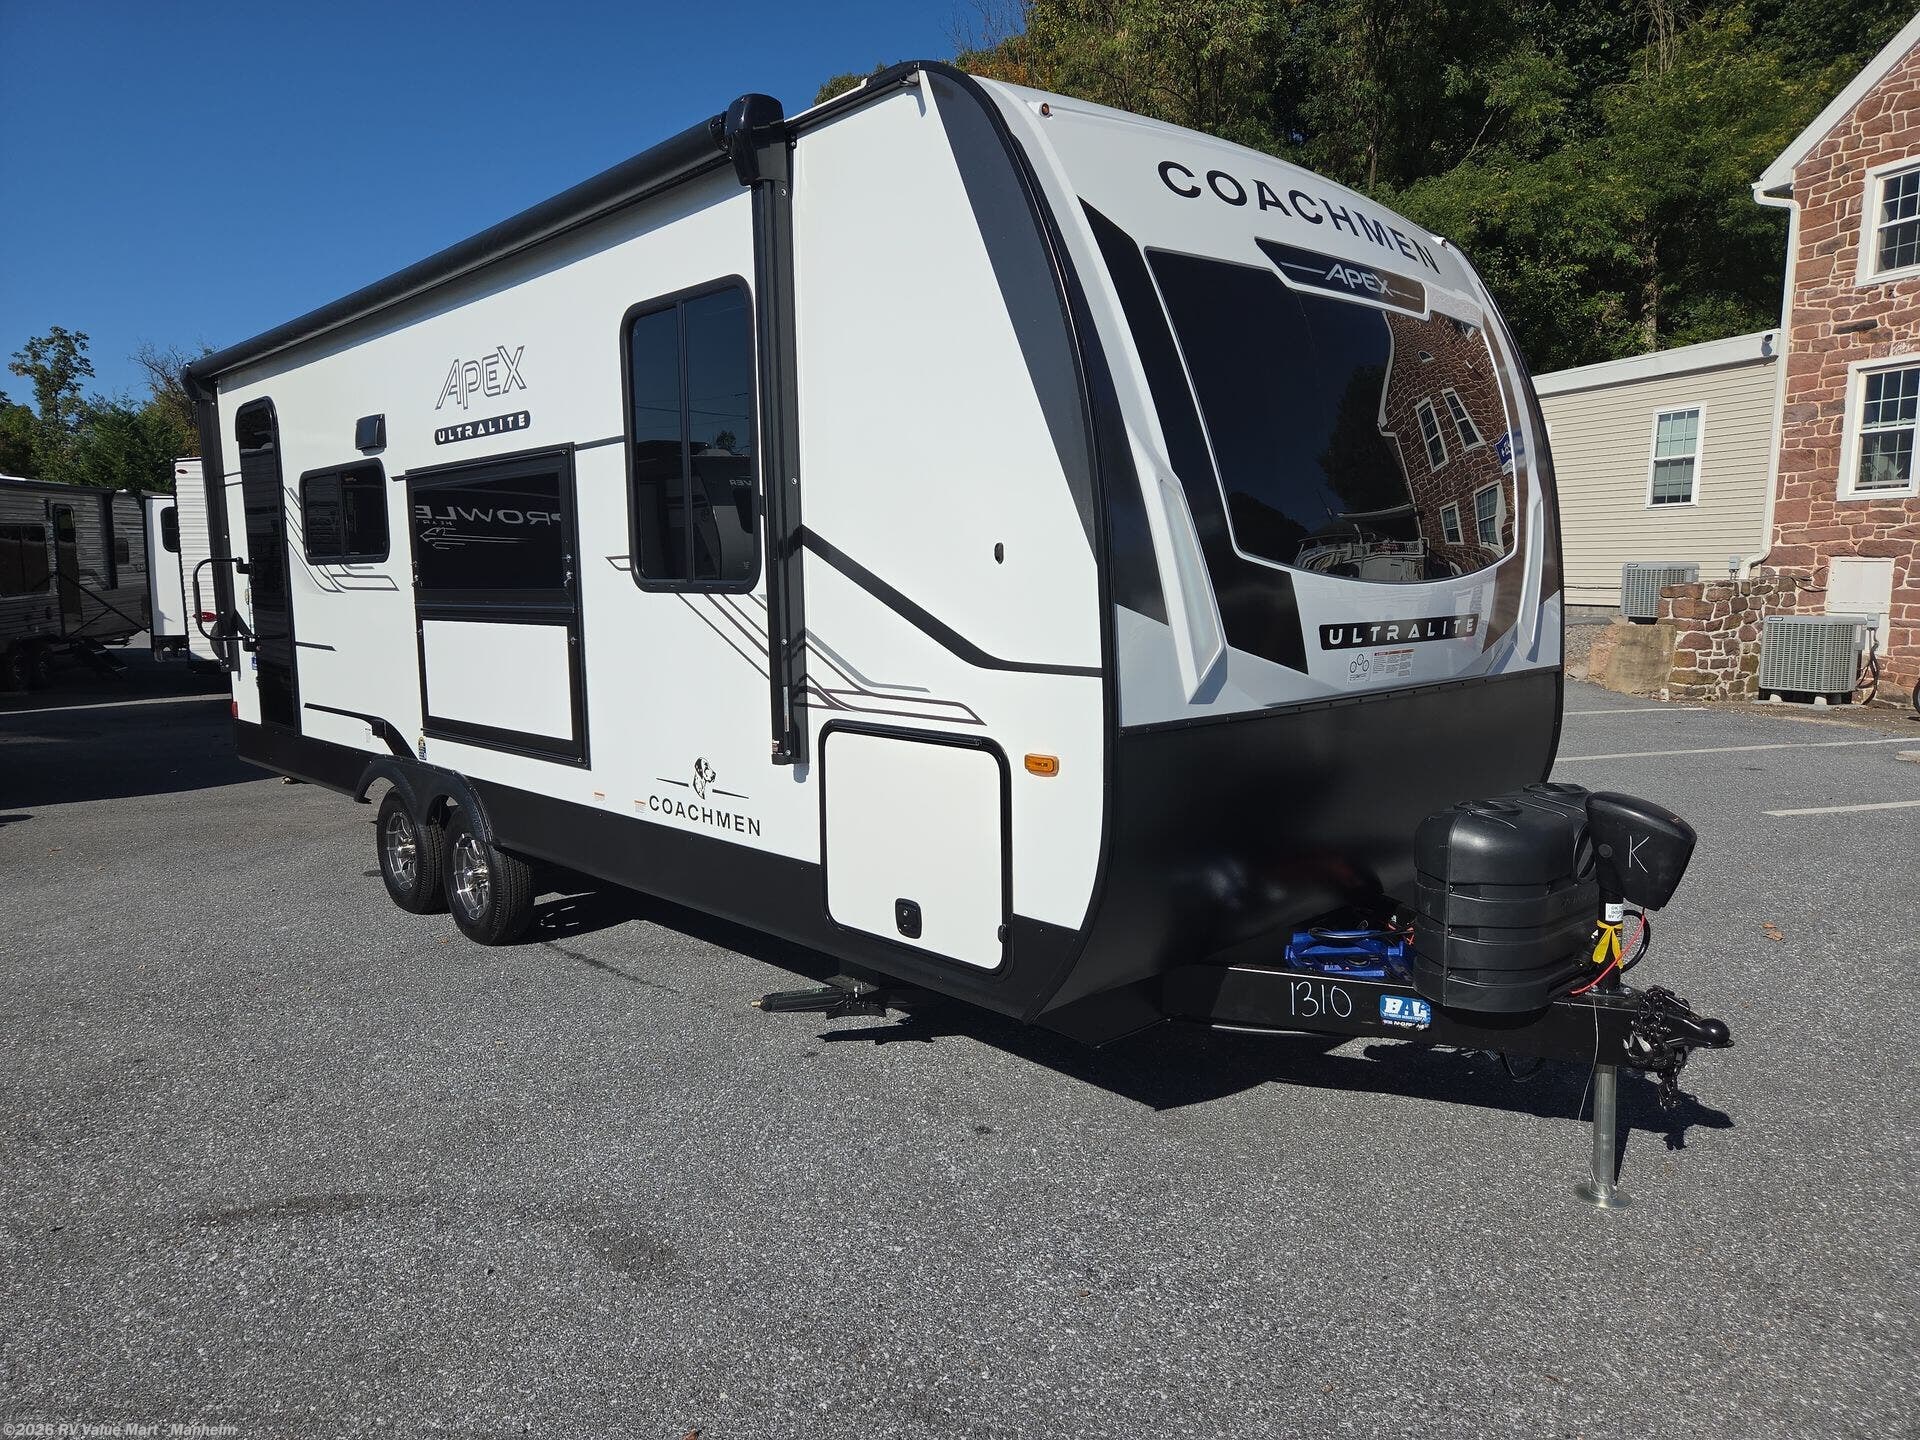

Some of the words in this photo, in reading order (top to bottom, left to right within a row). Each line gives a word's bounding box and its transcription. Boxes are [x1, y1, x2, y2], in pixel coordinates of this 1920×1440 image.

[1157, 160, 1441, 275] COACHMEN
[1325, 263, 1394, 297] APEX
[434, 344, 528, 410] APEX
[437, 414, 526, 442] ULTRALITE
[1328, 616, 1475, 645] ULTRALITE
[649, 795, 761, 837] COACHMEN
[1628, 834, 1650, 874] K
[1290, 981, 1352, 1017] 1310
